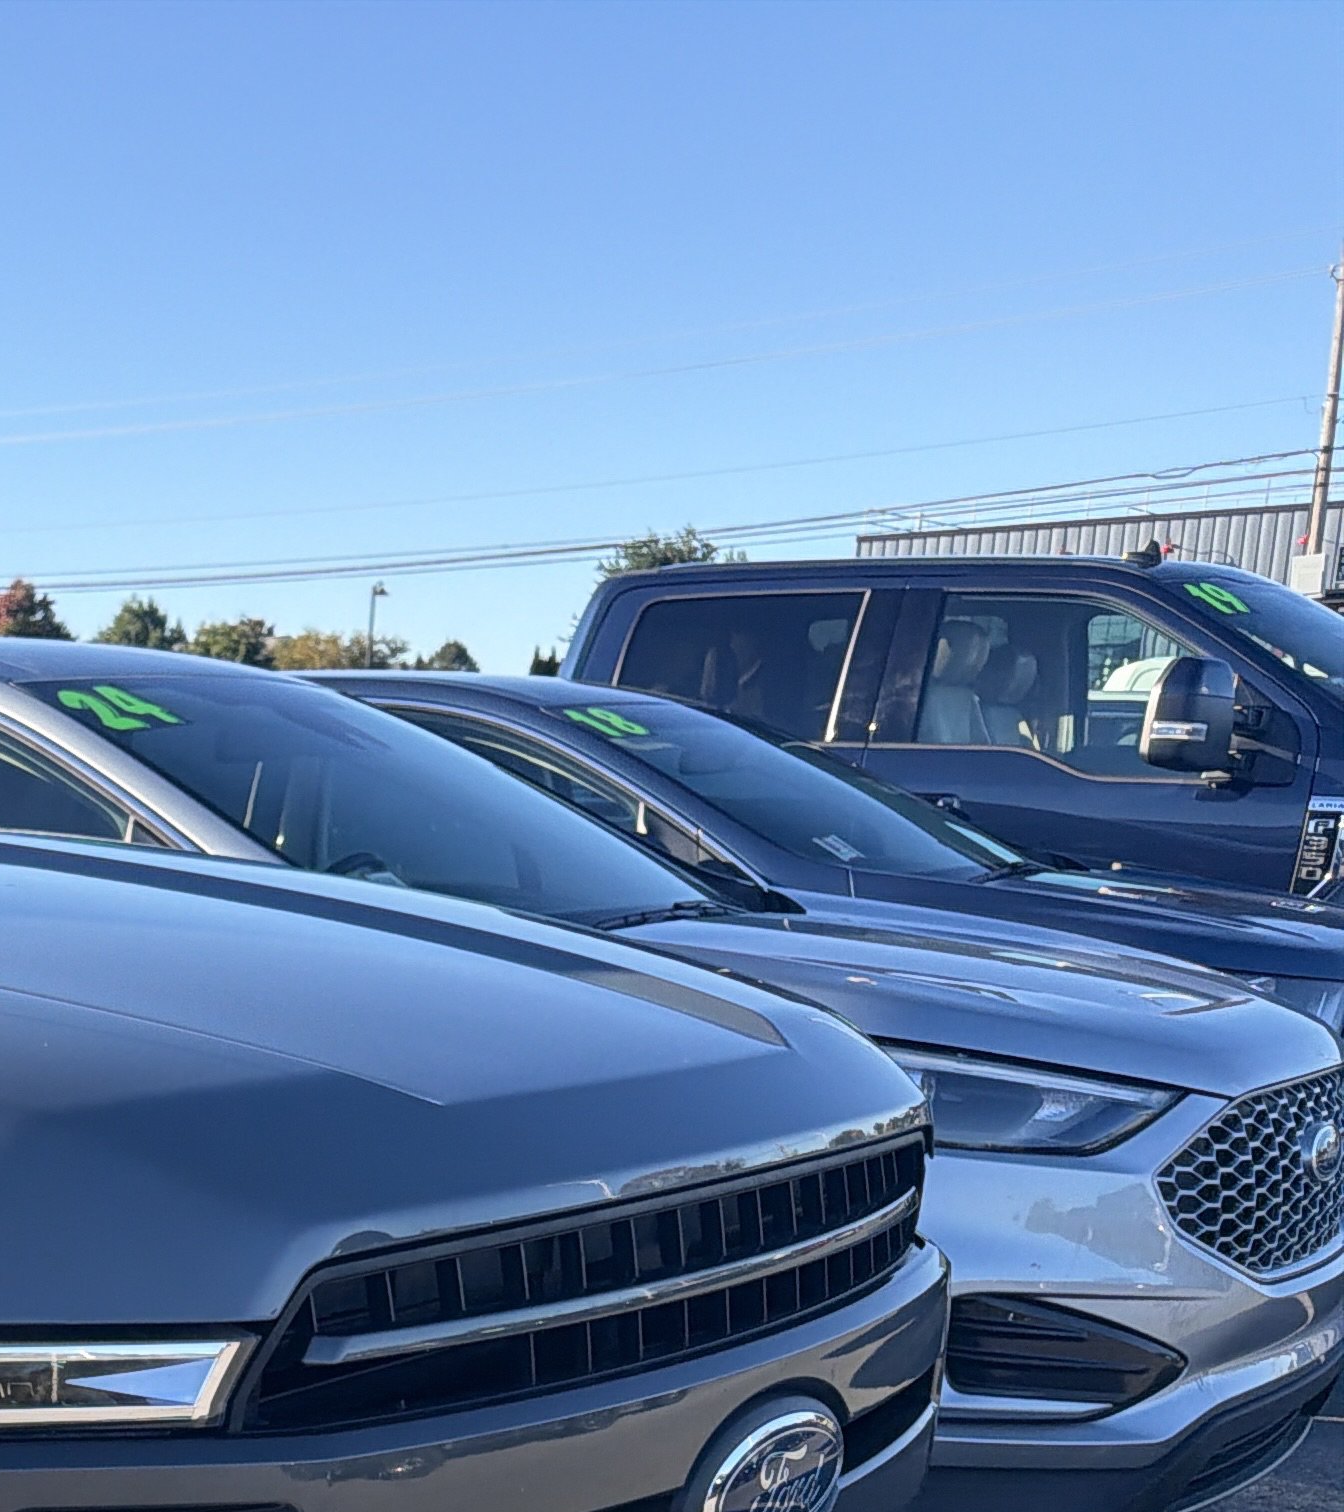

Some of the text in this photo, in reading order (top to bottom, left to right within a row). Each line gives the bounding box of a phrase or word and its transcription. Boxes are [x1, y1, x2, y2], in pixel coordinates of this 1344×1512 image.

[1183, 582, 1251, 614] 19
[57, 685, 186, 731] 24
[563, 707, 650, 737] 18
